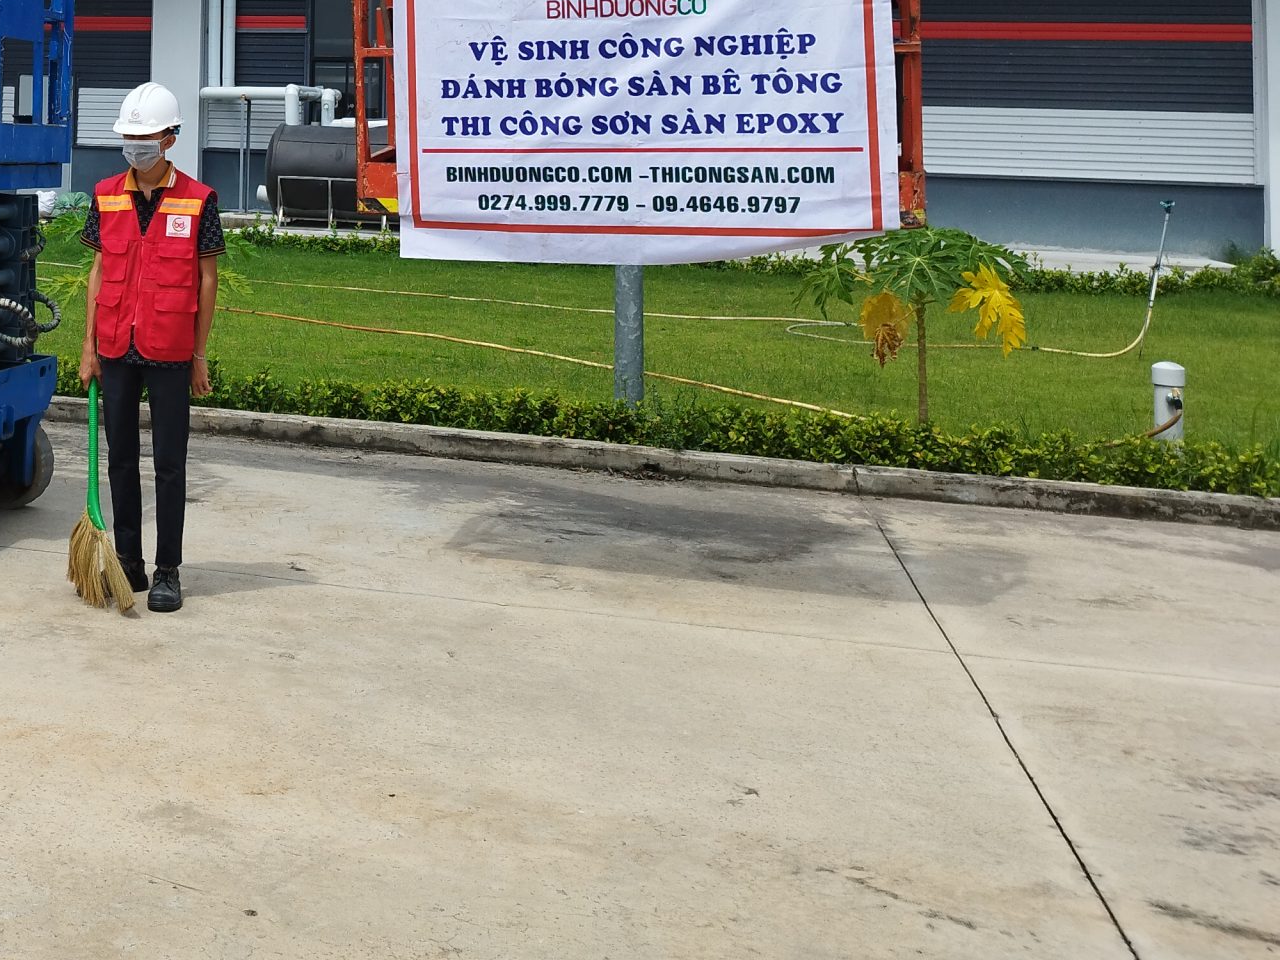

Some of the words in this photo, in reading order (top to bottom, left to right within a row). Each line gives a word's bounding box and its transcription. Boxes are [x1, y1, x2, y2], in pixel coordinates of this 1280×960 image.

[468, 35, 508, 66] VỆ
[518, 39, 590, 61] SINH
[598, 32, 686, 60] CÔNG
[693, 27, 817, 61] NGHIỆP
[440, 74, 527, 99] ĐÁNH
[534, 71, 620, 98] BÓNG
[627, 69, 693, 97] SÀN
[700, 67, 742, 96] BÊ
[750, 66, 843, 95] TÔNG
[441, 116, 492, 137] THI
[499, 110, 584, 136] CÔNG
[591, 110, 653, 136] SƠN
[661, 108, 727, 136] SÀN
[735, 112, 845, 135] EPOXY
[446, 166, 632, 183] BINHDUONGCO.COM
[478, 194, 629, 212] 0274.999.7779
[652, 195, 801, 214] 09.4646.9797
